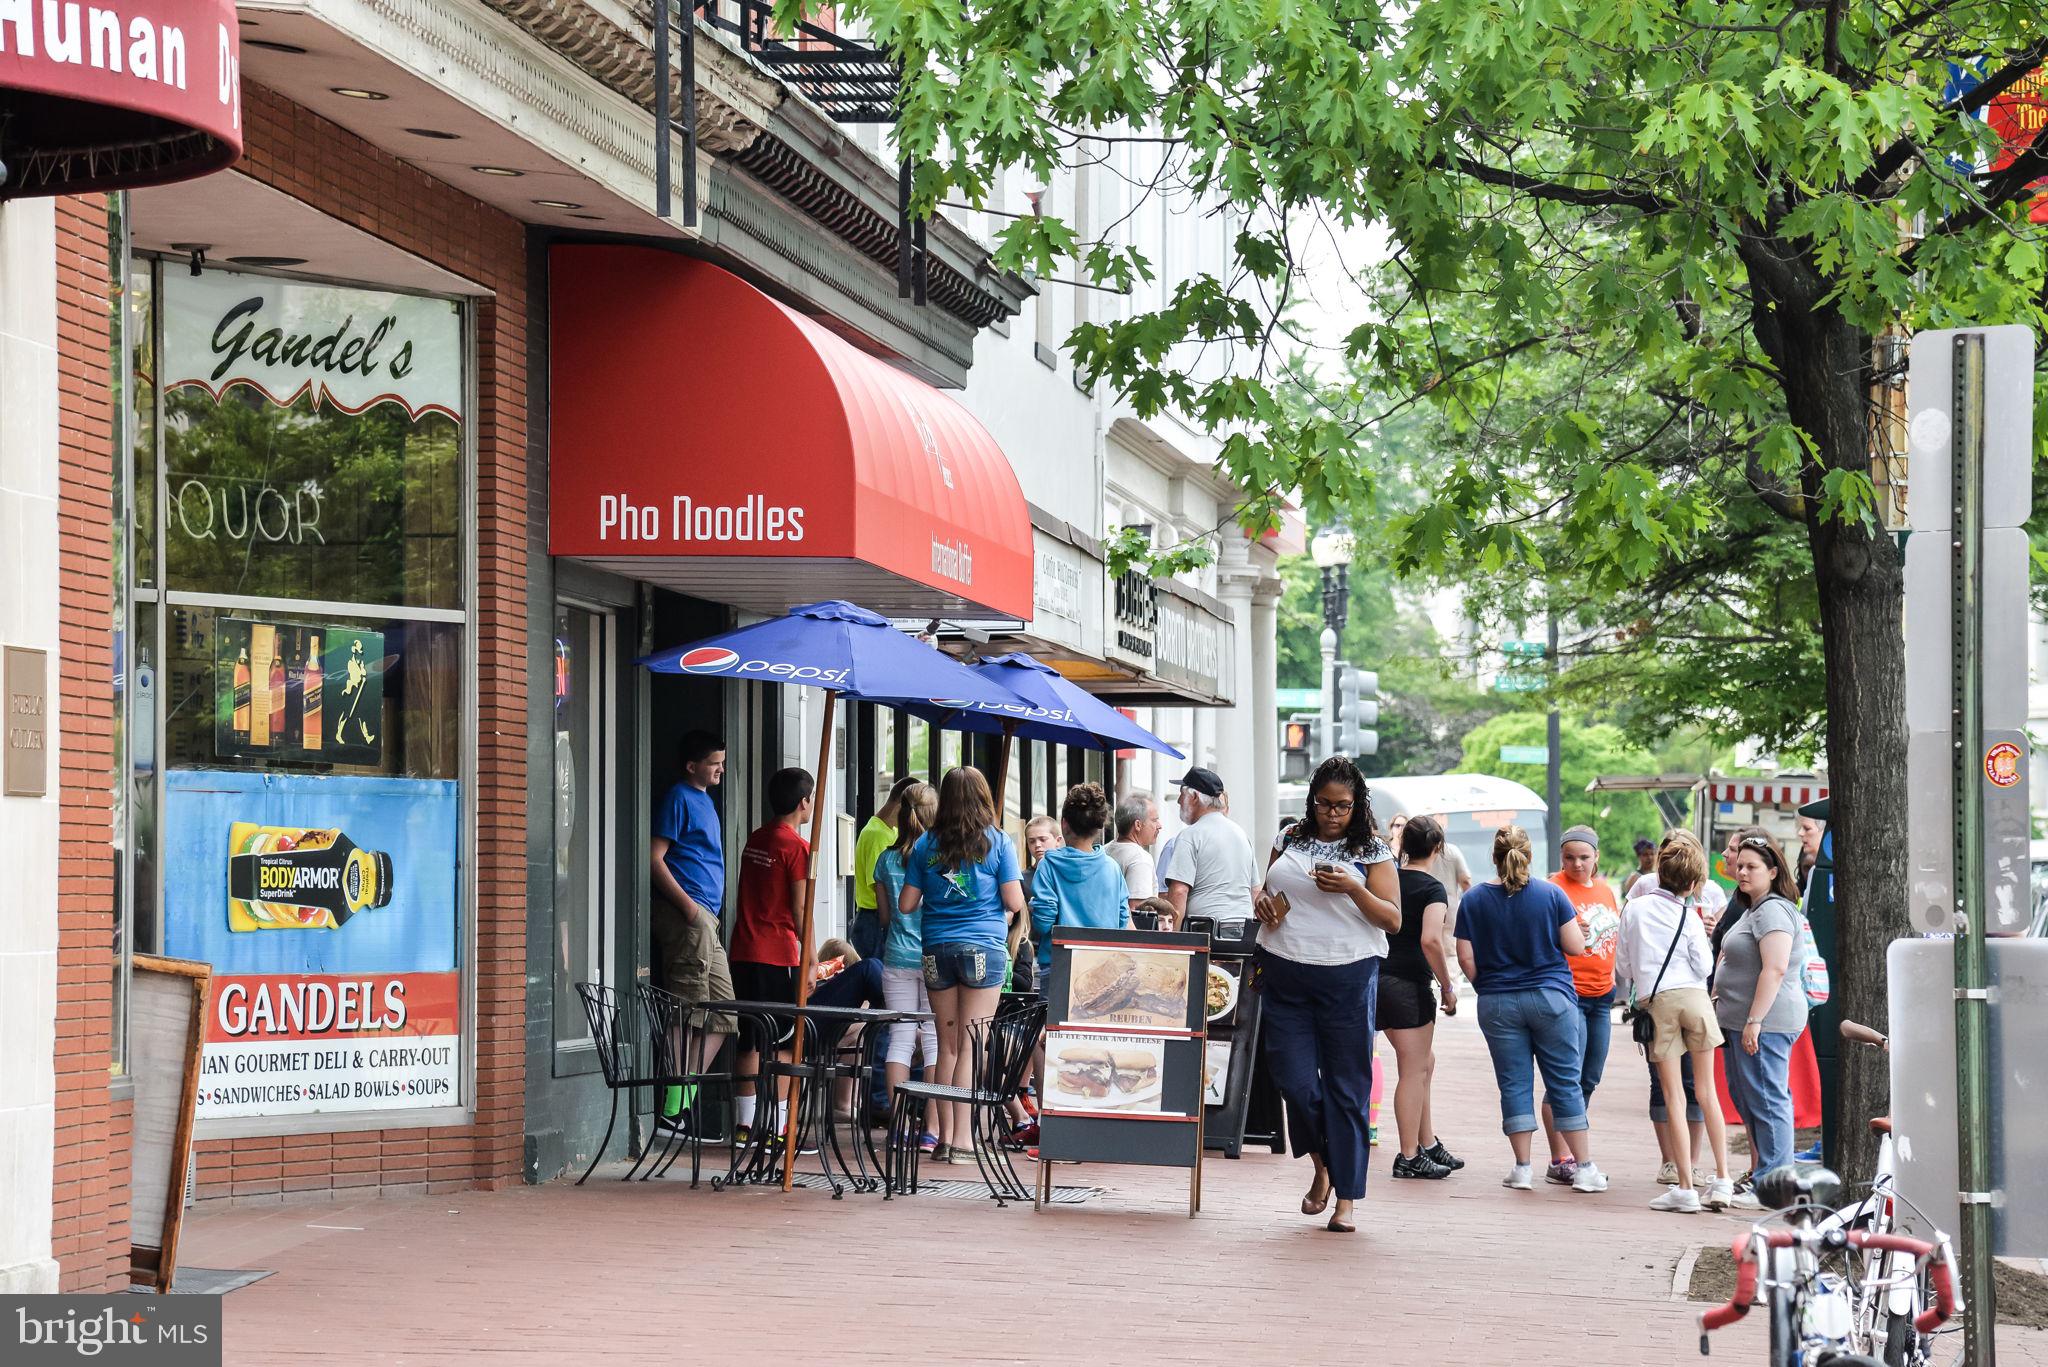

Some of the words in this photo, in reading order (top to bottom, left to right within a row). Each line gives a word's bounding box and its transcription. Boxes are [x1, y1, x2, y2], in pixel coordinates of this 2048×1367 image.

[0, 0, 187, 90] Hunan
[210, 296, 413, 381] Gandel's
[135, 479, 326, 545] IQUOR
[600, 493, 659, 540] Pho
[673, 494, 804, 541] Noodles
[1158, 605, 1186, 668] BURRITO
[1187, 616, 1217, 679] BROTHERS
[736, 660, 850, 684] pepsi
[260, 857, 278, 866] Tropical
[278, 857, 293, 865] Citrus
[260, 866, 340, 889] BODYARMOR
[218, 980, 407, 1036] GANDELS
[1109, 1013, 1152, 1025] REUBEN
[1048, 1031, 1063, 1039] RIB
[1130, 1037, 1161, 1045] CHEESE
[235, 1052, 309, 1074] GOURMET
[314, 1050, 347, 1070] DELI
[352, 1050, 364, 1069] &
[369, 1047, 451, 1068] CARRY-OUT
